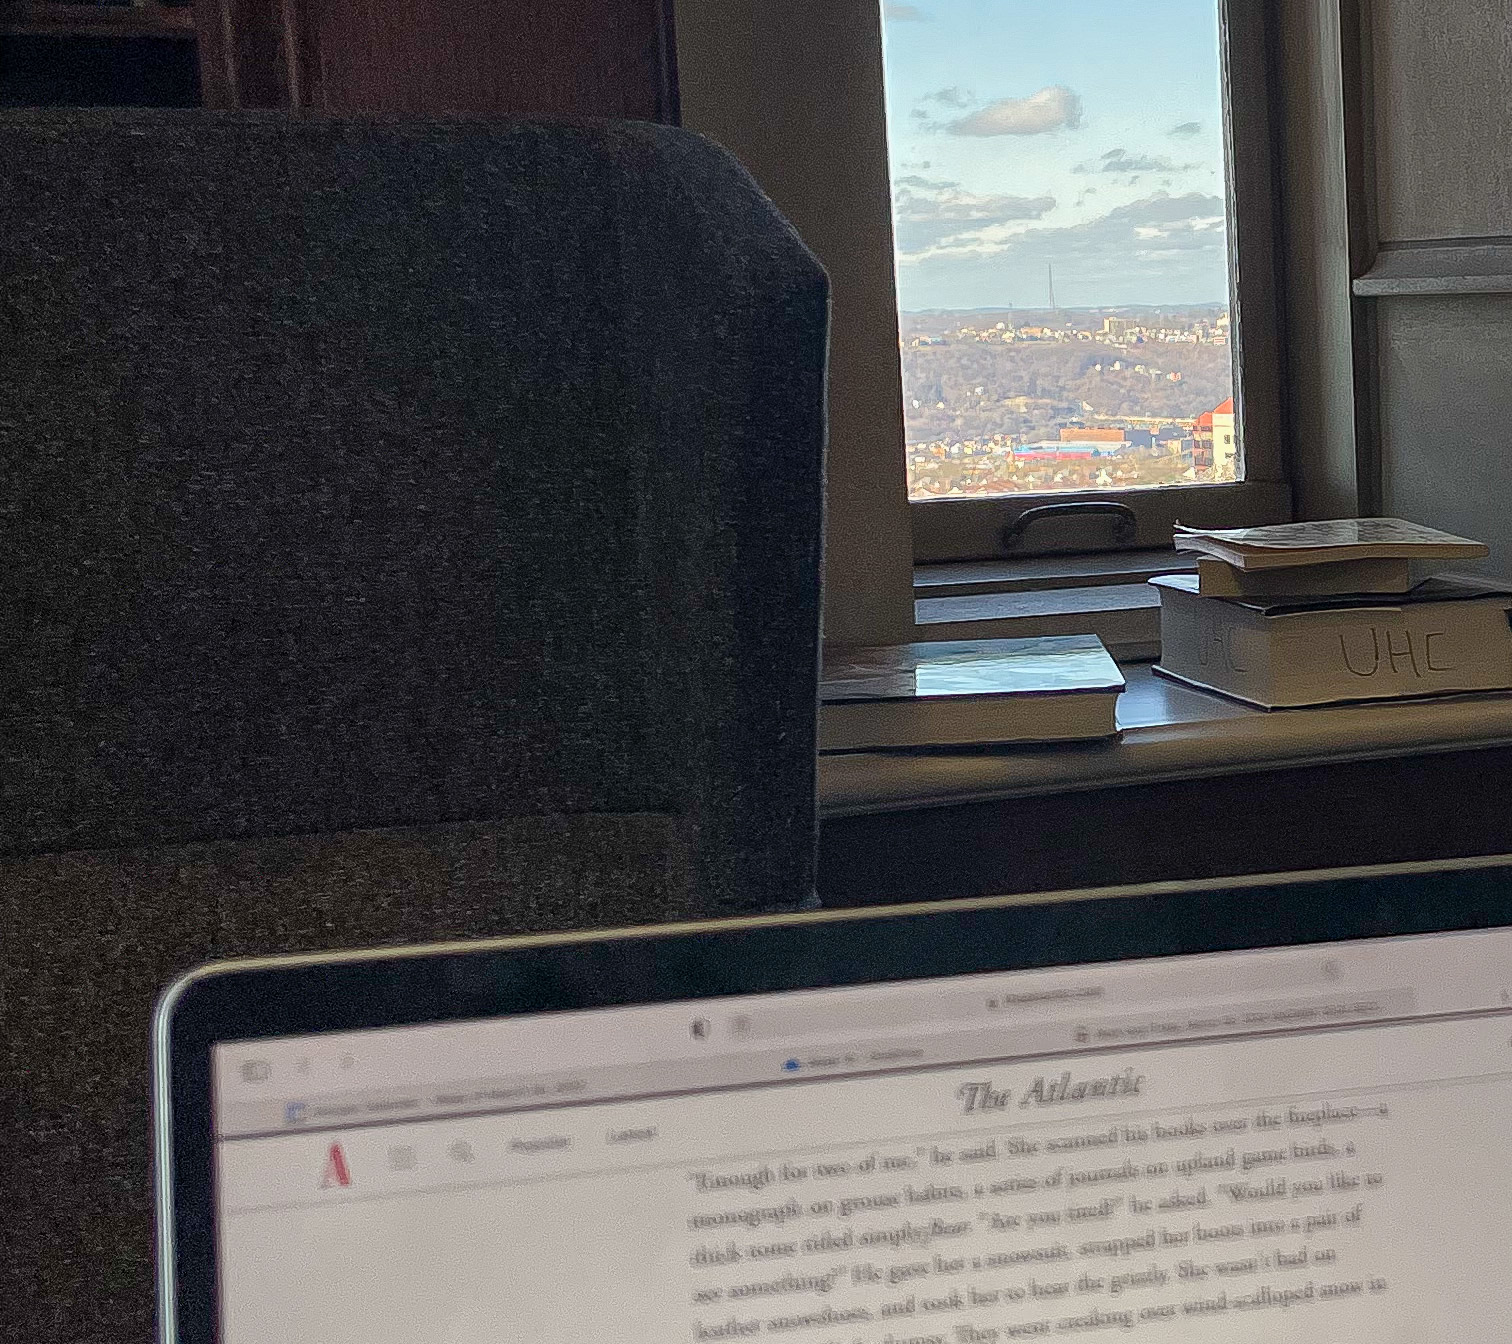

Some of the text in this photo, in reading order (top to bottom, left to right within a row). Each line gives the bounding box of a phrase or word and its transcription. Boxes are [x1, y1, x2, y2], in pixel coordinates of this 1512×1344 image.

[1339, 627, 1456, 678] UHC
[958, 1067, 1146, 1115] The Atlantic
